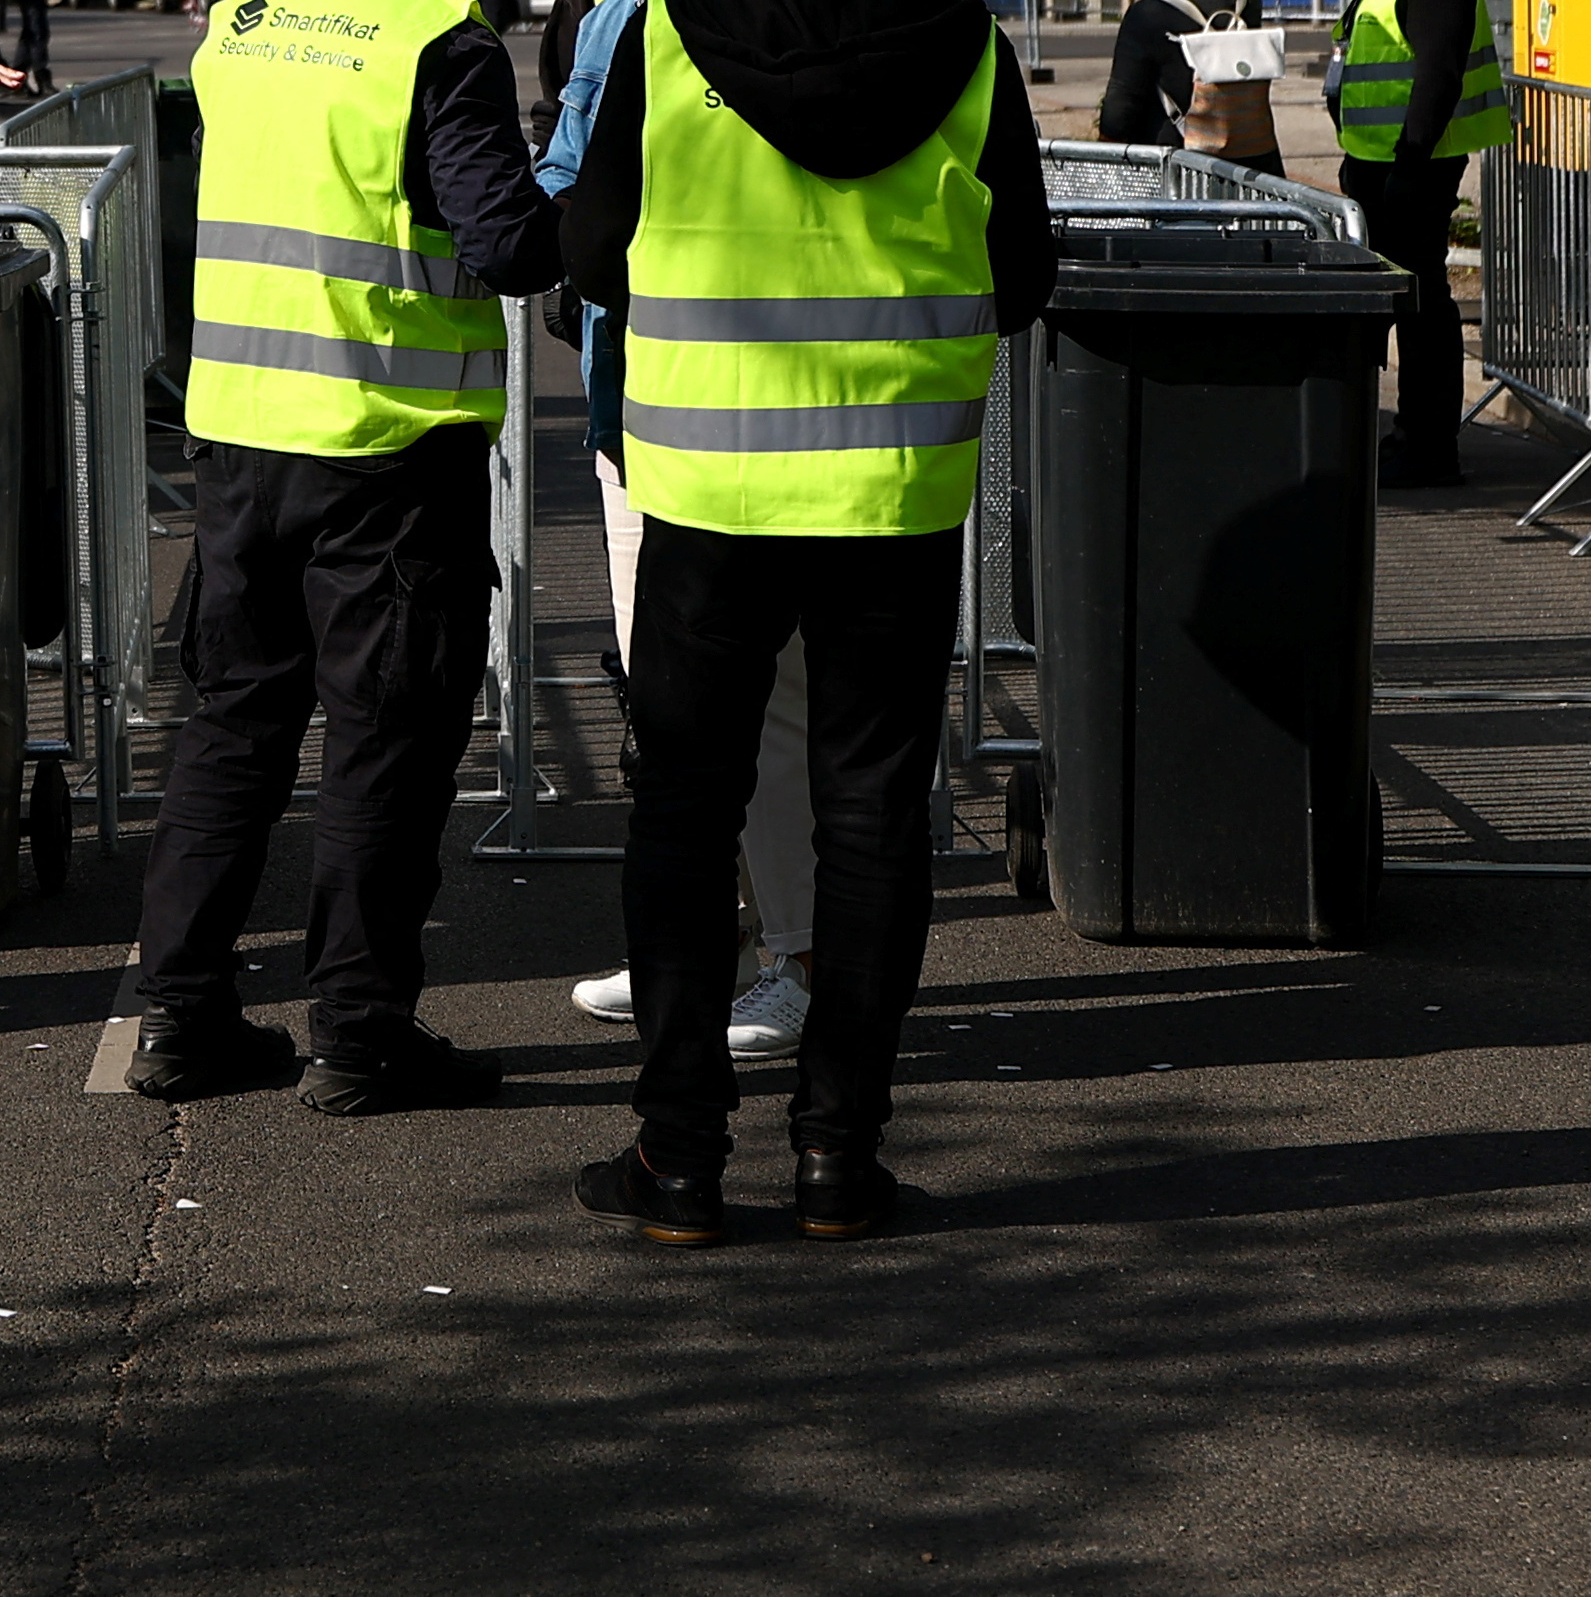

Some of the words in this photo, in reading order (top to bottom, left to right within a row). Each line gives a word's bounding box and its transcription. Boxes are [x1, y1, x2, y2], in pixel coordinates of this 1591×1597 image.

[269, 6, 381, 41] Smartifikat
[219, 37, 280, 62] Security
[283, 43, 296, 61] &
[301, 45, 364, 72] Service
